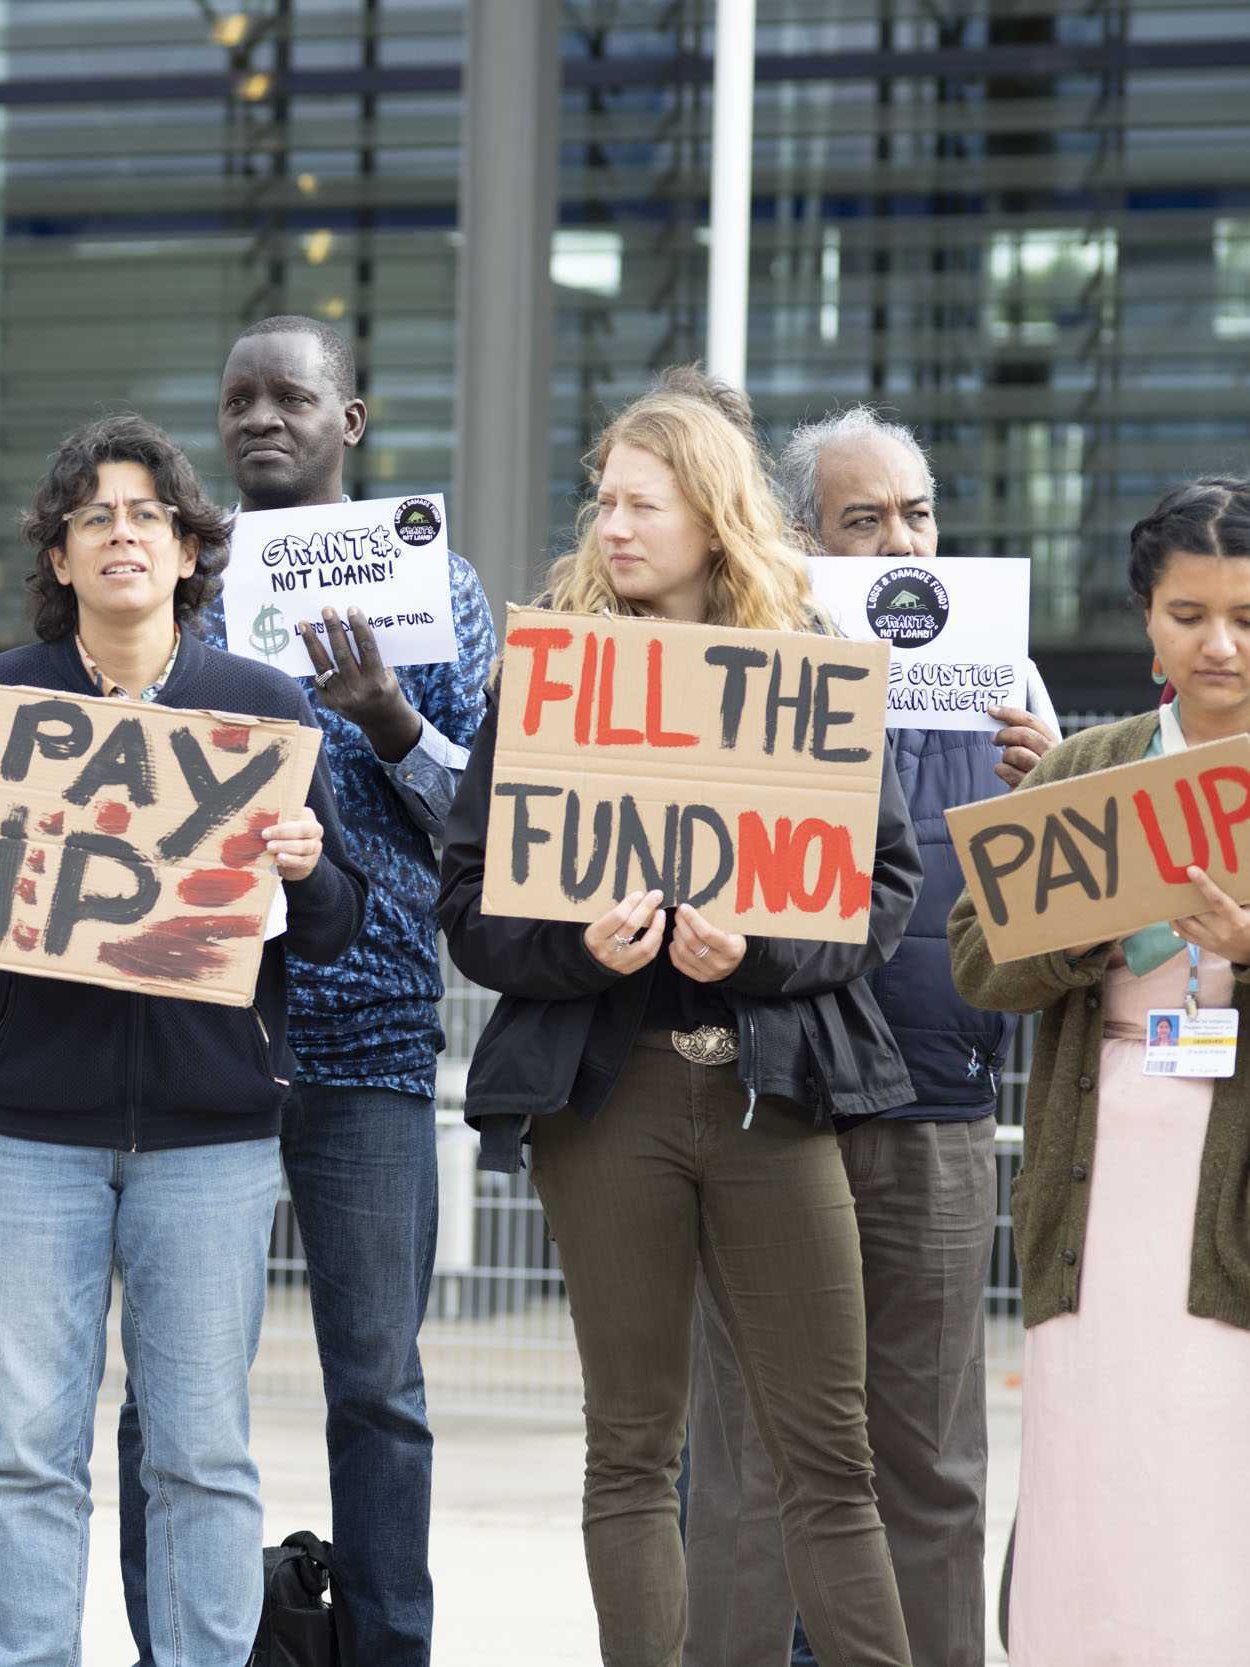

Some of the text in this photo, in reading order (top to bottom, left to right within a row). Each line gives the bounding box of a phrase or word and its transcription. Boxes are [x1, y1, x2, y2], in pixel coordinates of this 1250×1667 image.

[271, 560, 394, 593] NOT LOANS!
[889, 569, 932, 583] DAMAGE
[396, 612, 435, 626] FUND
[880, 628, 933, 639] NOT LOANS!
[907, 662, 1015, 688] JUSTICE
[506, 627, 873, 763] FILL THE
[932, 688, 1010, 713] RIGHT
[1, 699, 290, 863] PAY
[495, 782, 735, 910] FUND
[968, 766, 1250, 926] PAY UP
